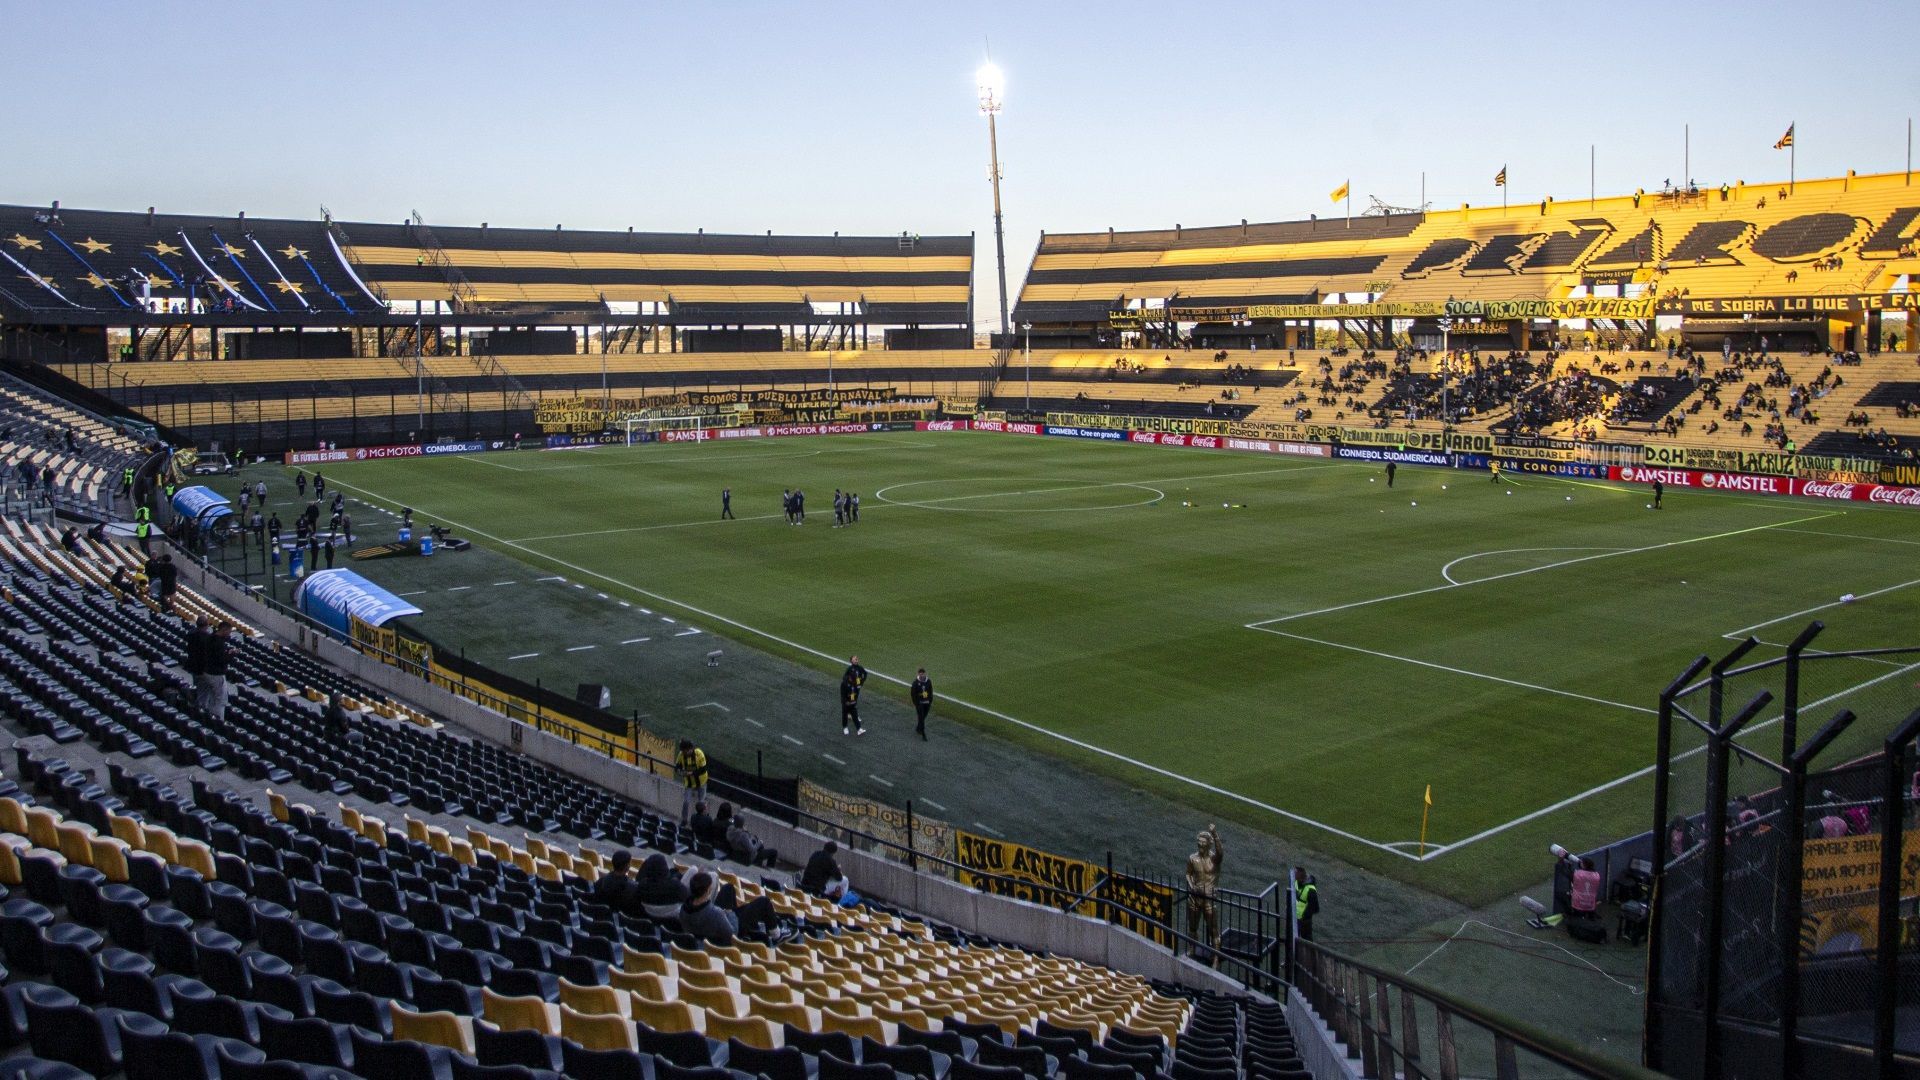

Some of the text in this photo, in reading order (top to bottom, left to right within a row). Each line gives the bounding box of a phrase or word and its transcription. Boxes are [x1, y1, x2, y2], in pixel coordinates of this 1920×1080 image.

[1445, 301, 1482, 314] SOCA
[1585, 300, 1602, 317] LA
[1602, 298, 1655, 318] FIESTA
[1691, 294, 1920, 312] ME SOBRA LO QUE TE FA
[1251, 307, 1272, 317] DESDE
[1274, 306, 1287, 316] 1891
[1289, 306, 1297, 316] LA
[1299, 306, 1321, 316] MEJOR
[1323, 305, 1359, 315] HINCHADA
[1360, 304, 1373, 314] DEL
[1376, 303, 1401, 314] MUNDO
[615, 398, 637, 410] PARA
[639, 393, 688, 408] ENTENDIDOS
[703, 390, 881, 404] SOMOS EL PUEBLO Y EL CARNAVAL
[536, 412, 567, 423] PIEDRAS
[581, 411, 613, 422] BLANCAS
[777, 427, 789, 435] MG
[790, 426, 817, 435] MOTOR
[828, 425, 840, 433] MG
[841, 424, 867, 432] MOTOR
[927, 420, 954, 431] Coca-Cola
[979, 421, 1003, 431] AMSTEL
[1013, 423, 1037, 434] AMSTEL
[1154, 418, 1192, 433] BUCEO
[1194, 420, 1229, 435] PORVENIR
[1229, 421, 1298, 432] ETERNAMENTE
[570, 436, 595, 445] GRAN
[599, 434, 652, 443] CONQISTA
[676, 430, 710, 440] AMSTEL
[1049, 427, 1079, 436] CONMEBOL
[1080, 429, 1093, 437] Cree
[1101, 430, 1121, 440] grande
[1230, 427, 1305, 440] GORDO FABIAN
[300, 453, 320, 462] FÚTBOL
[328, 451, 349, 460] FÚTBOL
[369, 448, 386, 458] MG
[386, 446, 423, 456] MOTOR
[1339, 448, 1447, 465] CONMEBOL SUDAMERICANA
[1468, 458, 1481, 466] LA
[1523, 462, 1596, 476] CONQUISTA
[1795, 455, 1835, 470] PARQUE
[1635, 468, 1691, 486] AMSTEL
[1717, 475, 1778, 492] AMSTEL
[1798, 470, 1879, 485] LA ESCAFANDRA
[1803, 480, 1856, 499] Coca-Cola
